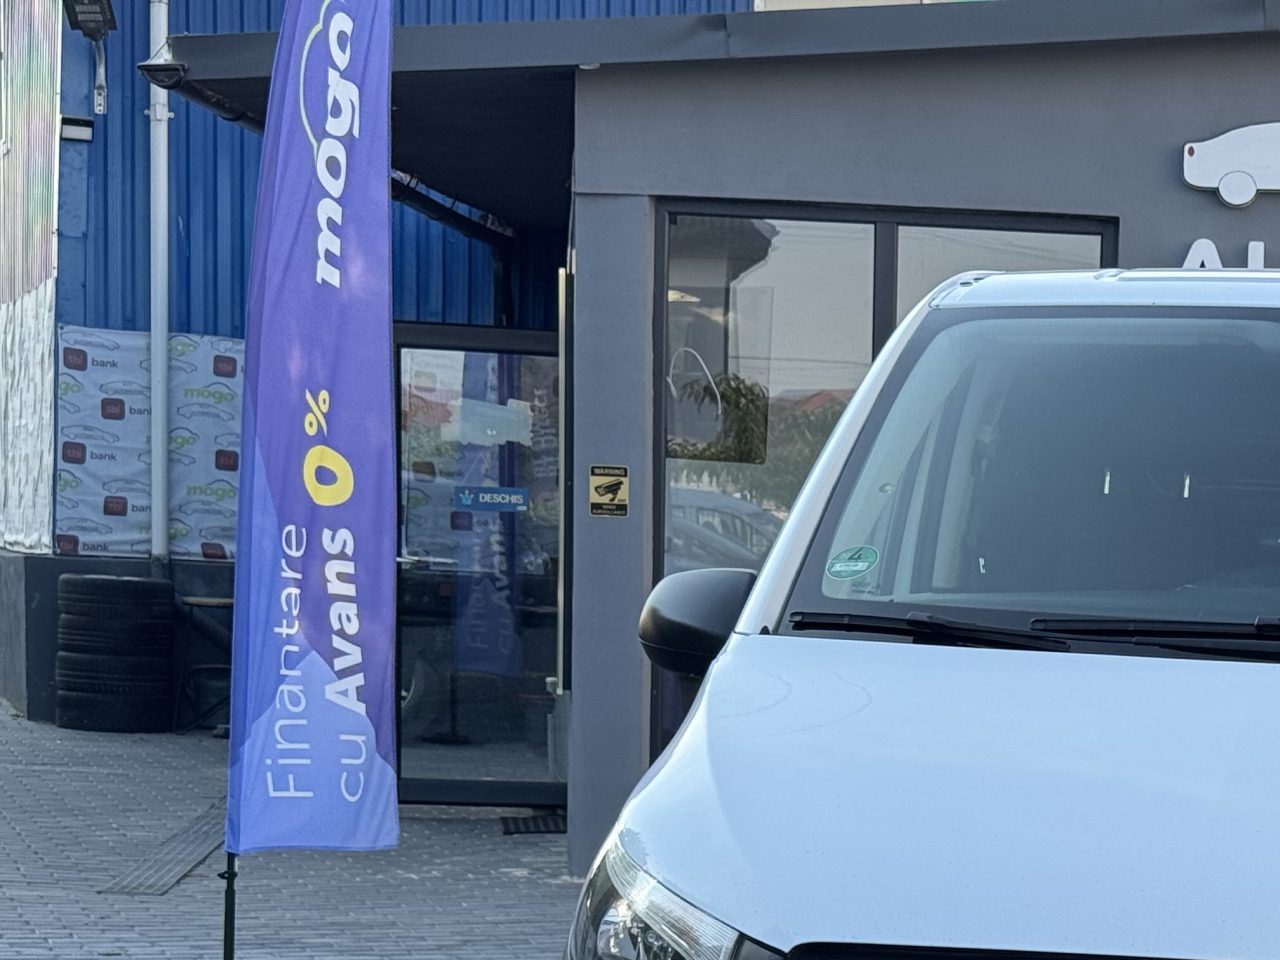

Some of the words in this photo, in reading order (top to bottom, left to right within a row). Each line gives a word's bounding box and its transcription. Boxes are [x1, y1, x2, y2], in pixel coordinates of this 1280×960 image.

[315, 11, 361, 289] mogo
[91, 357, 118, 369] bank
[183, 387, 236, 404] mogo
[90, 451, 117, 462] bank
[186, 484, 237, 501] mogo
[479, 492, 524, 504] DESCHIS
[131, 503, 151, 513] ban
[82, 543, 110, 551] bank
[322, 527, 367, 716] Avans
[265, 524, 314, 798] Finantare
[340, 733, 366, 803] cu
